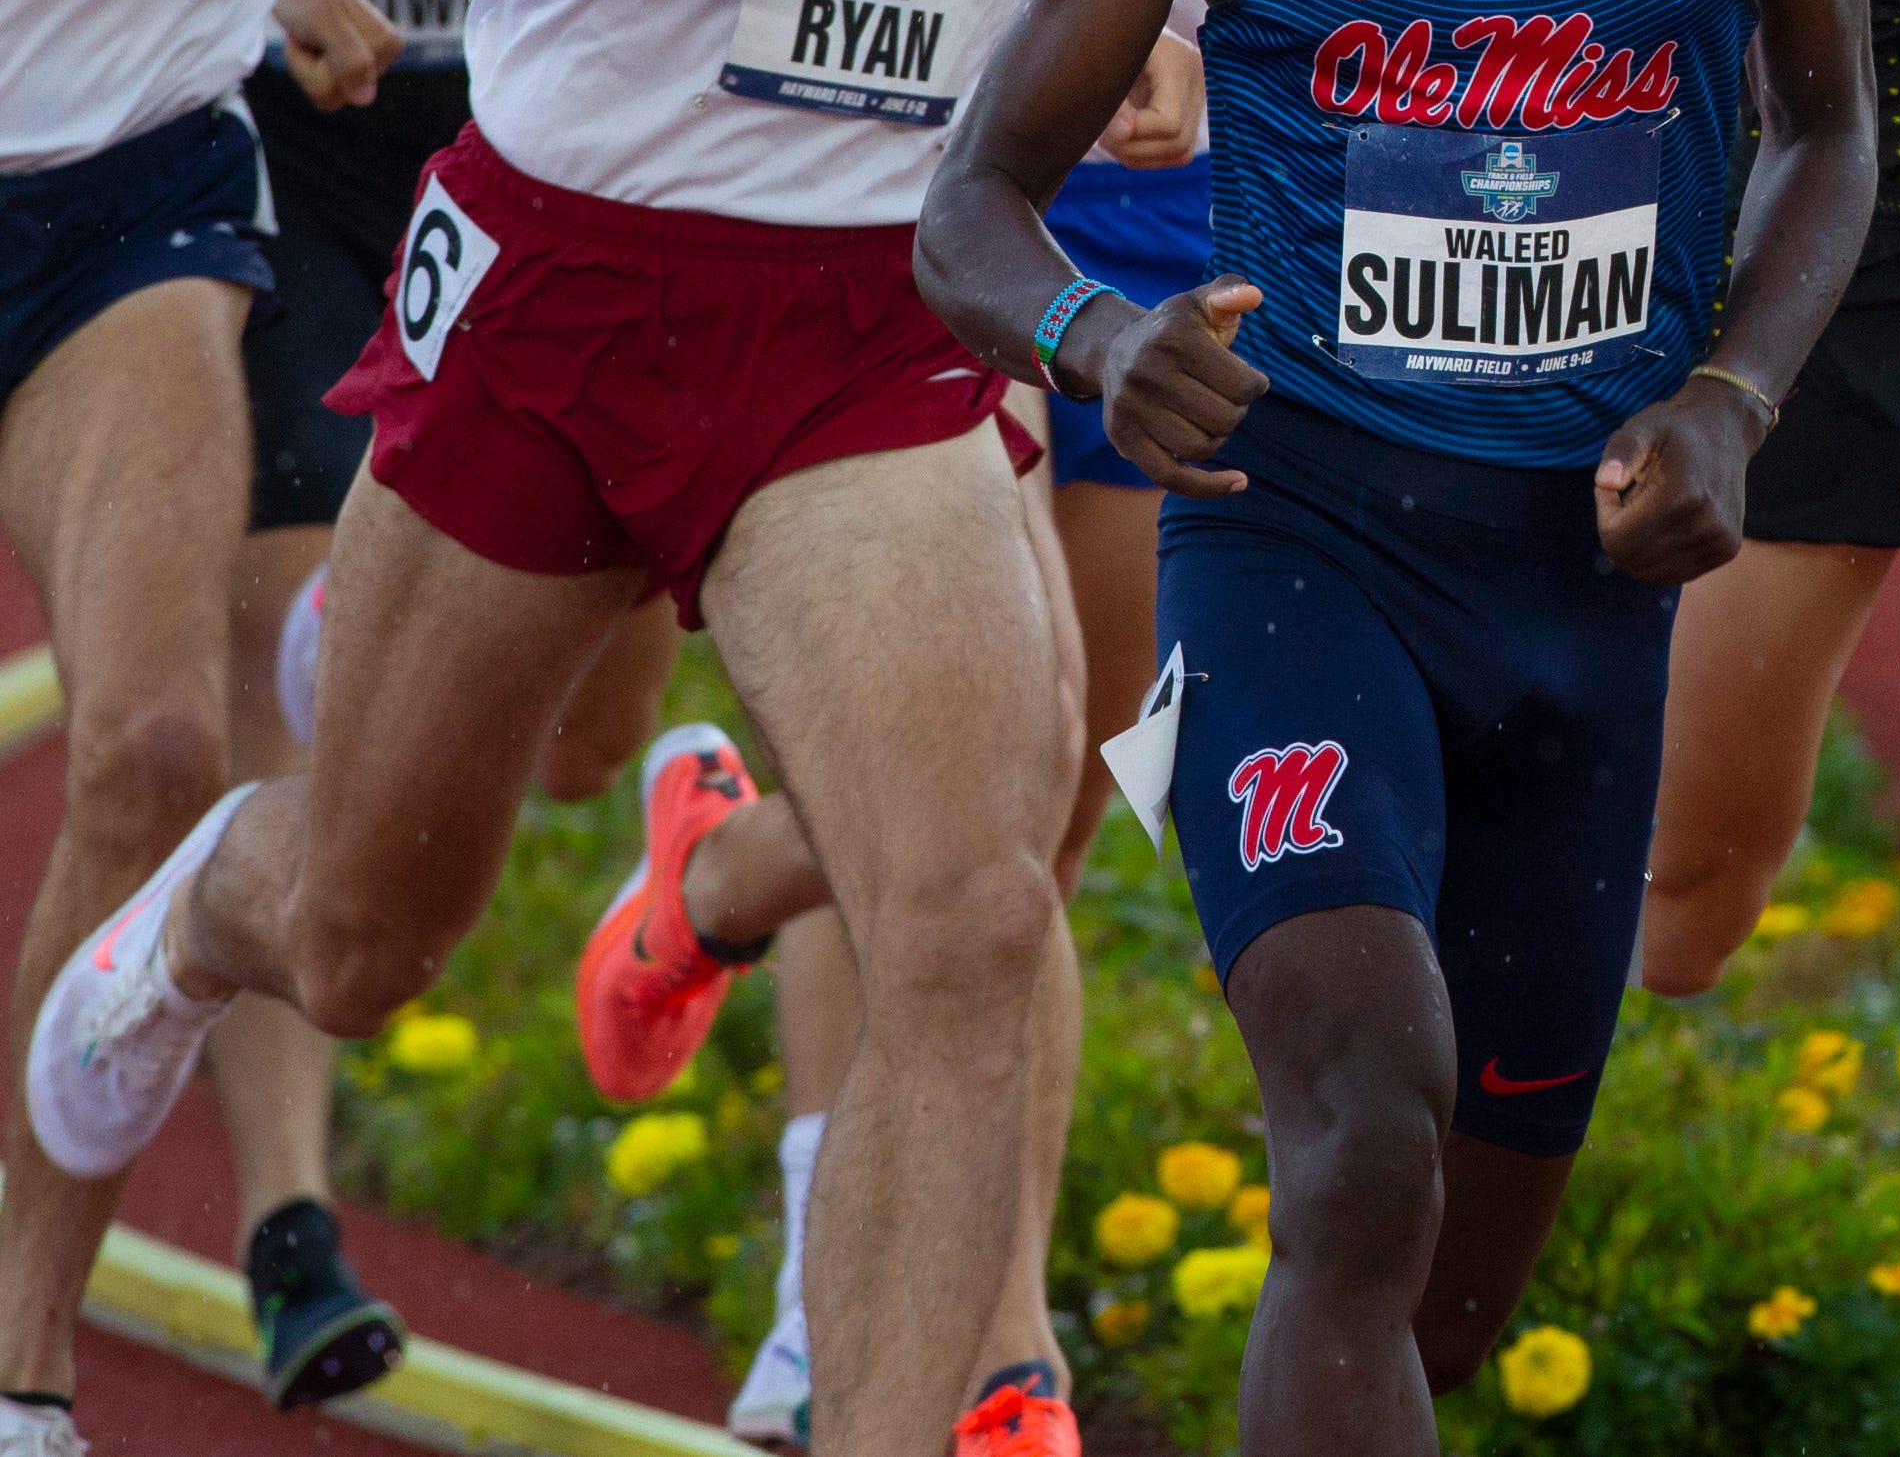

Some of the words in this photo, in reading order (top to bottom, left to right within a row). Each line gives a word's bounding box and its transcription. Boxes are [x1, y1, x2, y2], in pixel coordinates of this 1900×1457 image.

[1311, 18, 1458, 127] Ole
[1451, 11, 1681, 132] Miss
[1469, 177, 1552, 192] CHAMPIONSHIPS
[1486, 171, 1509, 180] TRACK
[1515, 172, 1535, 181] FIELD
[403, 207, 464, 343] 6
[1444, 227, 1571, 264] WALEED
[1343, 245, 1650, 347] SULIMAN
[1405, 354, 1473, 373] HAYWARD
[1474, 359, 1512, 375] FIELD
[1535, 354, 1568, 374] JUNE
[1568, 349, 1595, 368] 9-12
[1228, 739, 1349, 873] M
